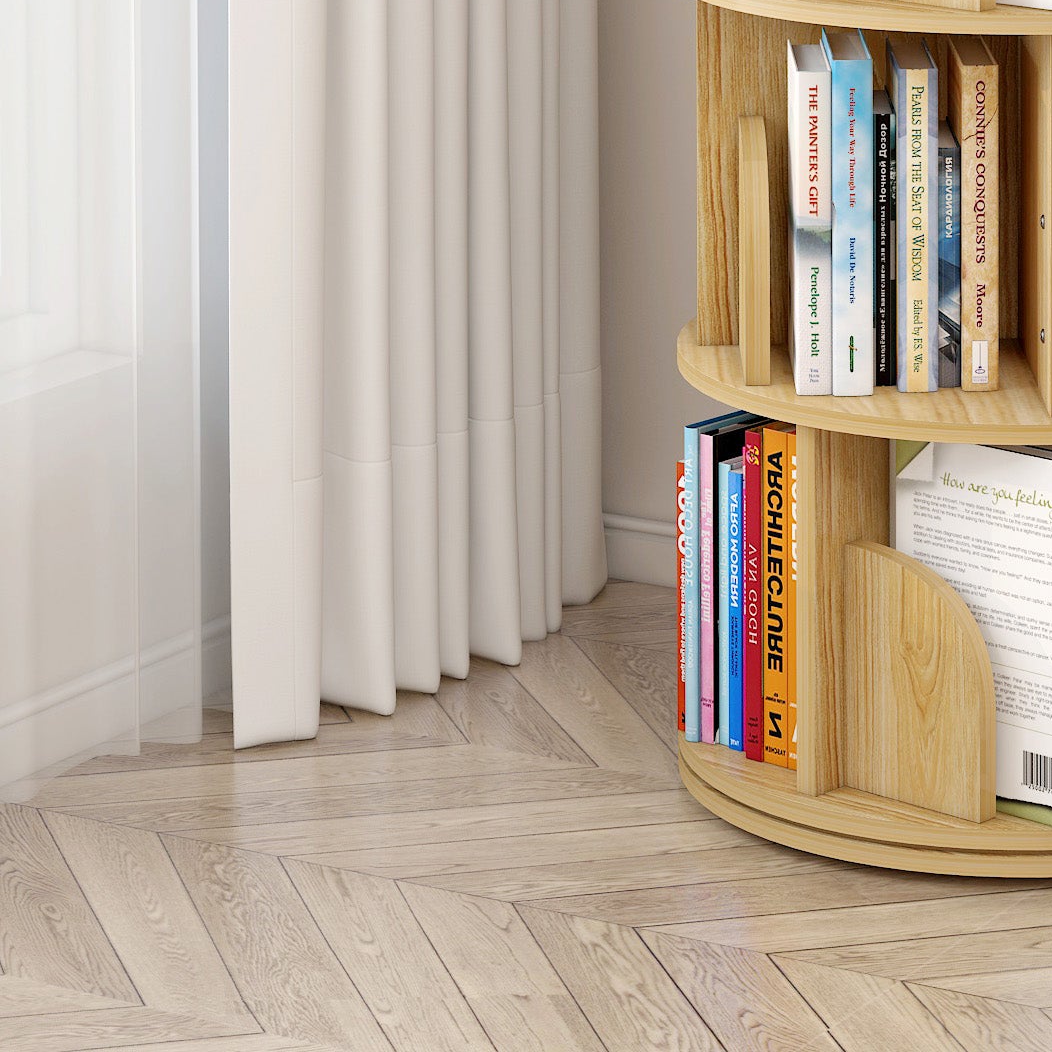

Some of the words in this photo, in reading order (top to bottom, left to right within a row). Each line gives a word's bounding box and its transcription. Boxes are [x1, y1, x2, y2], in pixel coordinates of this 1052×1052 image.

[809, 85, 819, 112] THE
[847, 88, 857, 116] Feeling
[911, 86, 925, 125] PEARLS
[847, 119, 856, 137] Your
[974, 80, 986, 158] CONNIE'S
[809, 116, 819, 182] PAINTER'S
[847, 140, 856, 155] Way
[878, 123, 888, 158] Дозор
[911, 129, 922, 157] FROM
[847, 157, 857, 190] Through
[878, 161, 887, 202] Ночной
[912, 161, 922, 183] THE
[809, 186, 819, 216] GIFT
[848, 193, 857, 208] Life
[911, 186, 925, 213] SEAT
[944, 157, 954, 238] КАРДИОЛОГИЯ
[912, 217, 922, 231] OF
[974, 163, 986, 264] CONQUESTS
[848, 237, 857, 260] David
[911, 234, 925, 282] WISDOM
[848, 262, 857, 273] De
[808, 267, 820, 317] Penelope
[848, 276, 857, 304] Notaris
[913, 299, 924, 324] Edited
[976, 283, 986, 328] Moore
[809, 321, 819, 329] J.
[911, 326, 924, 336] by
[811, 333, 820, 357] Holt
[913, 354, 924, 373] Wise
[939, 471, 965, 489] How
[968, 482, 989, 495] are
[991, 486, 1013, 505] you
